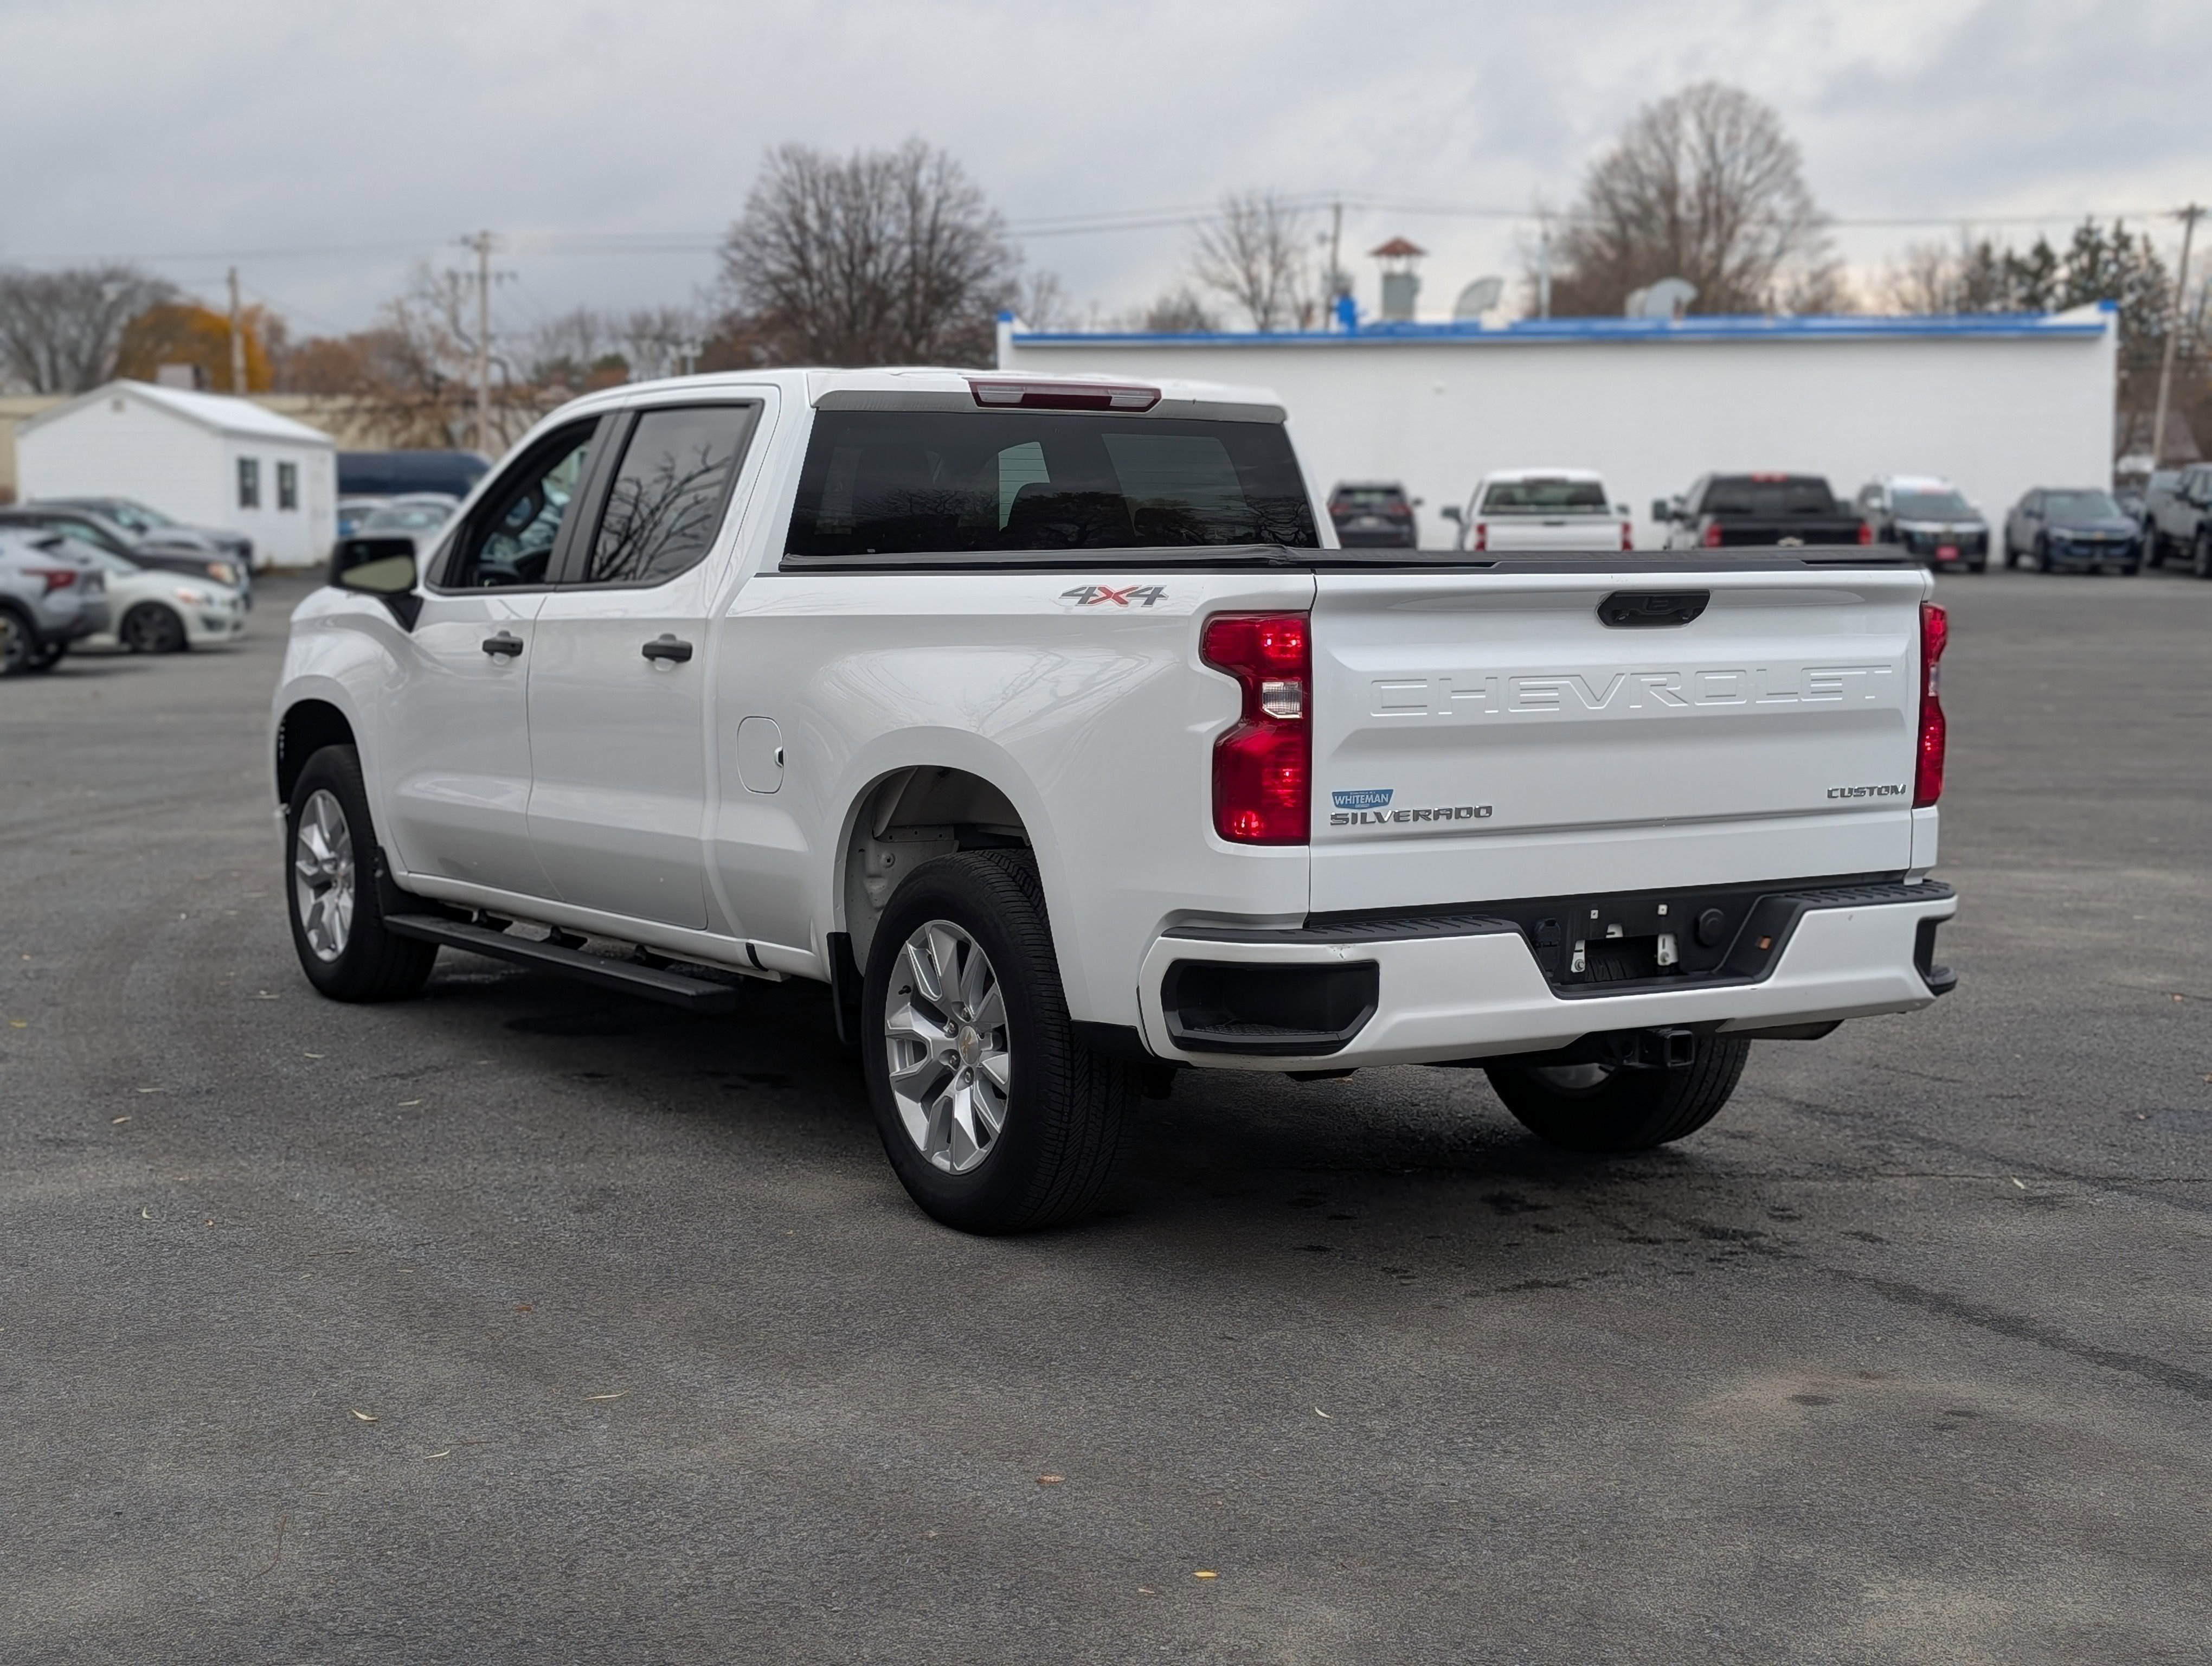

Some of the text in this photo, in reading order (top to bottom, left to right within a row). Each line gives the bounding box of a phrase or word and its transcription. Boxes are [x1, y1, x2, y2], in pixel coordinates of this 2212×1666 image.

[1370, 665, 1892, 716] CHEVROLET
[1335, 793, 1388, 805] WHITEMAN
[1827, 784, 1906, 798] CUSTOM
[1330, 806, 1492, 825] SILVERADO
